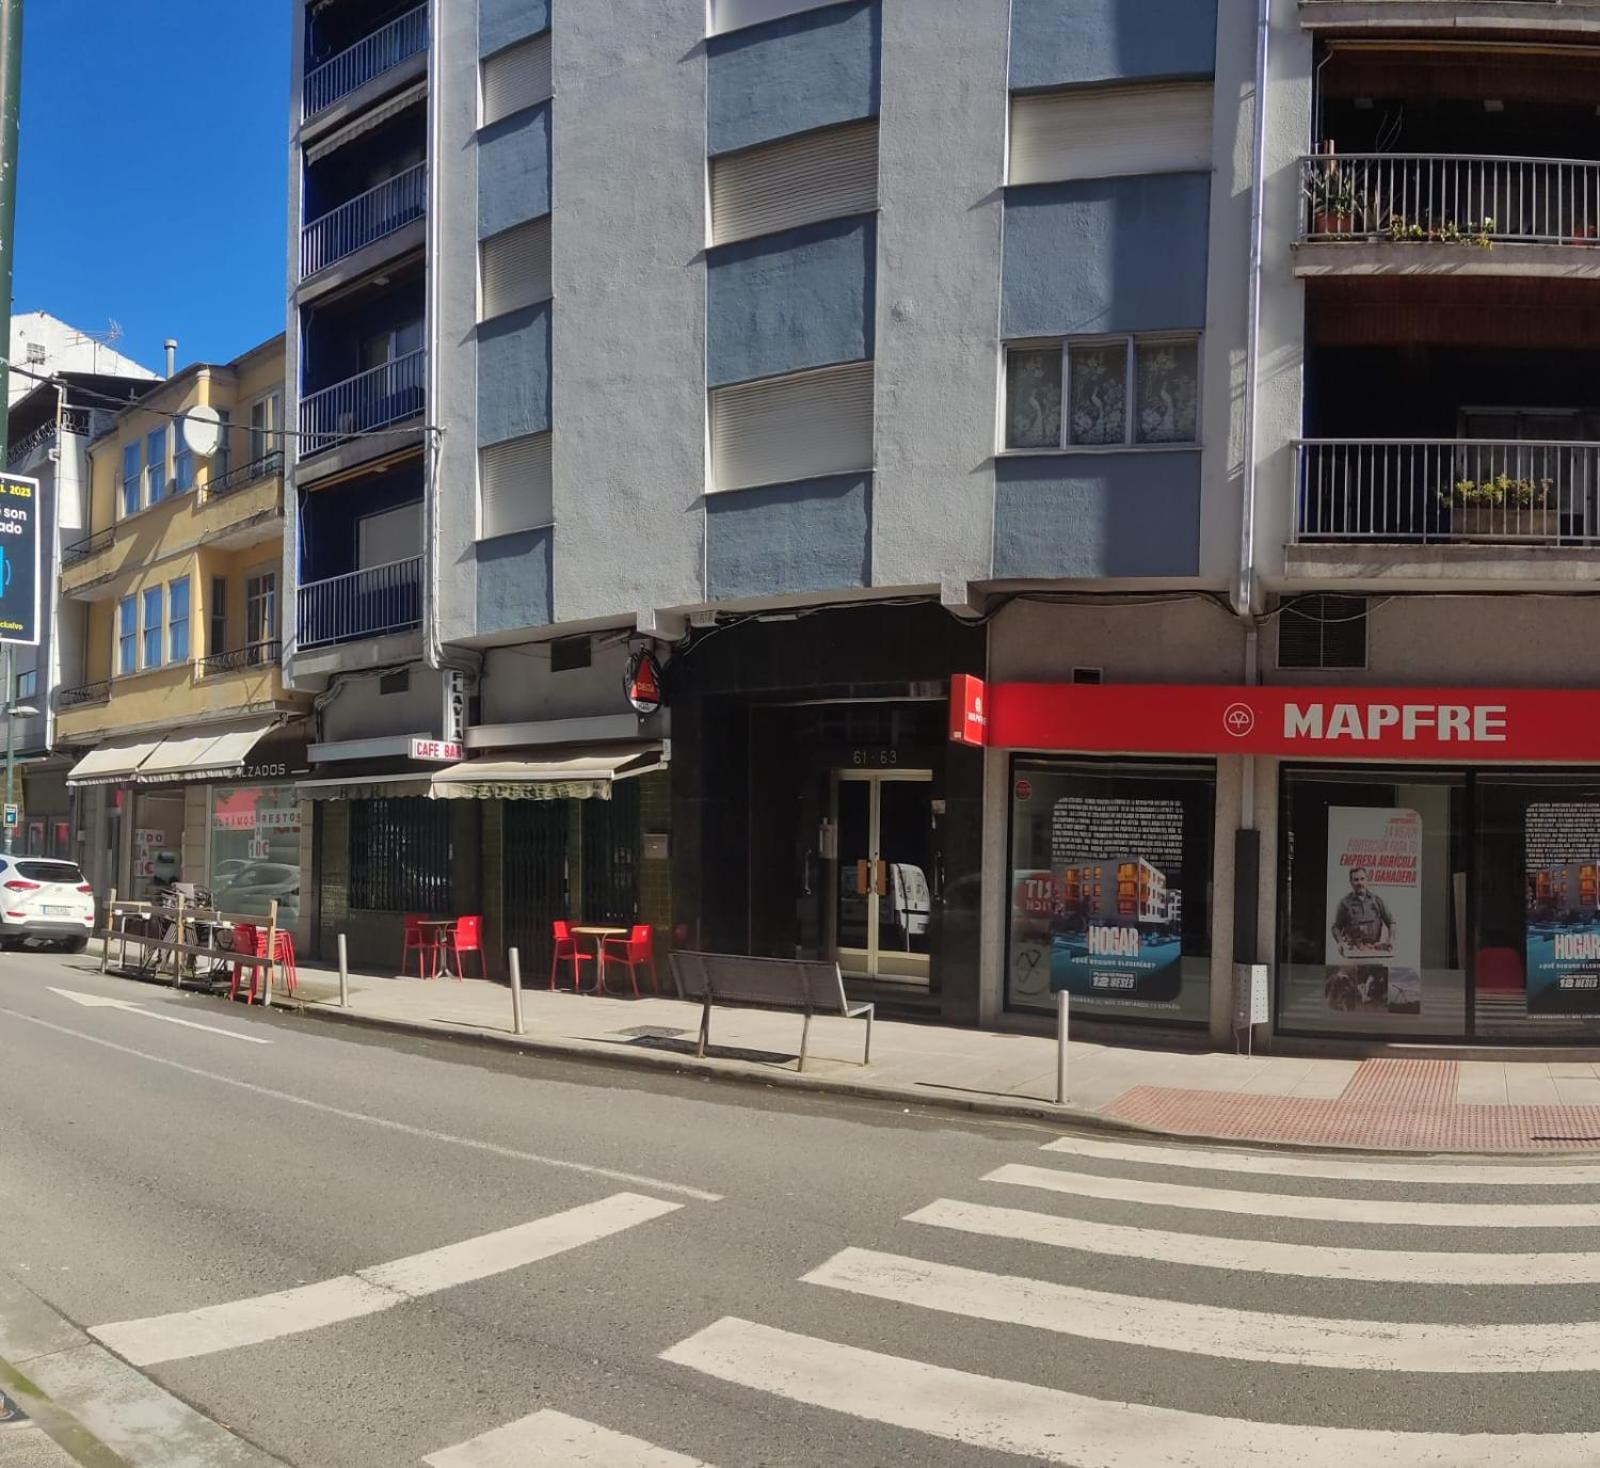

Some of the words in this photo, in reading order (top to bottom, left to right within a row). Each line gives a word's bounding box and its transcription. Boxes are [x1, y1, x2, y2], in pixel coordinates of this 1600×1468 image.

[4, 508, 27, 520] son
[453, 672, 463, 739] FLAVIA
[1285, 703, 1507, 741] MAPFRE
[416, 742, 440, 757] CAFE
[444, 744, 462, 758] BAR
[880, 750, 897, 764] 63
[1088, 925, 1138, 957] HOGAR
